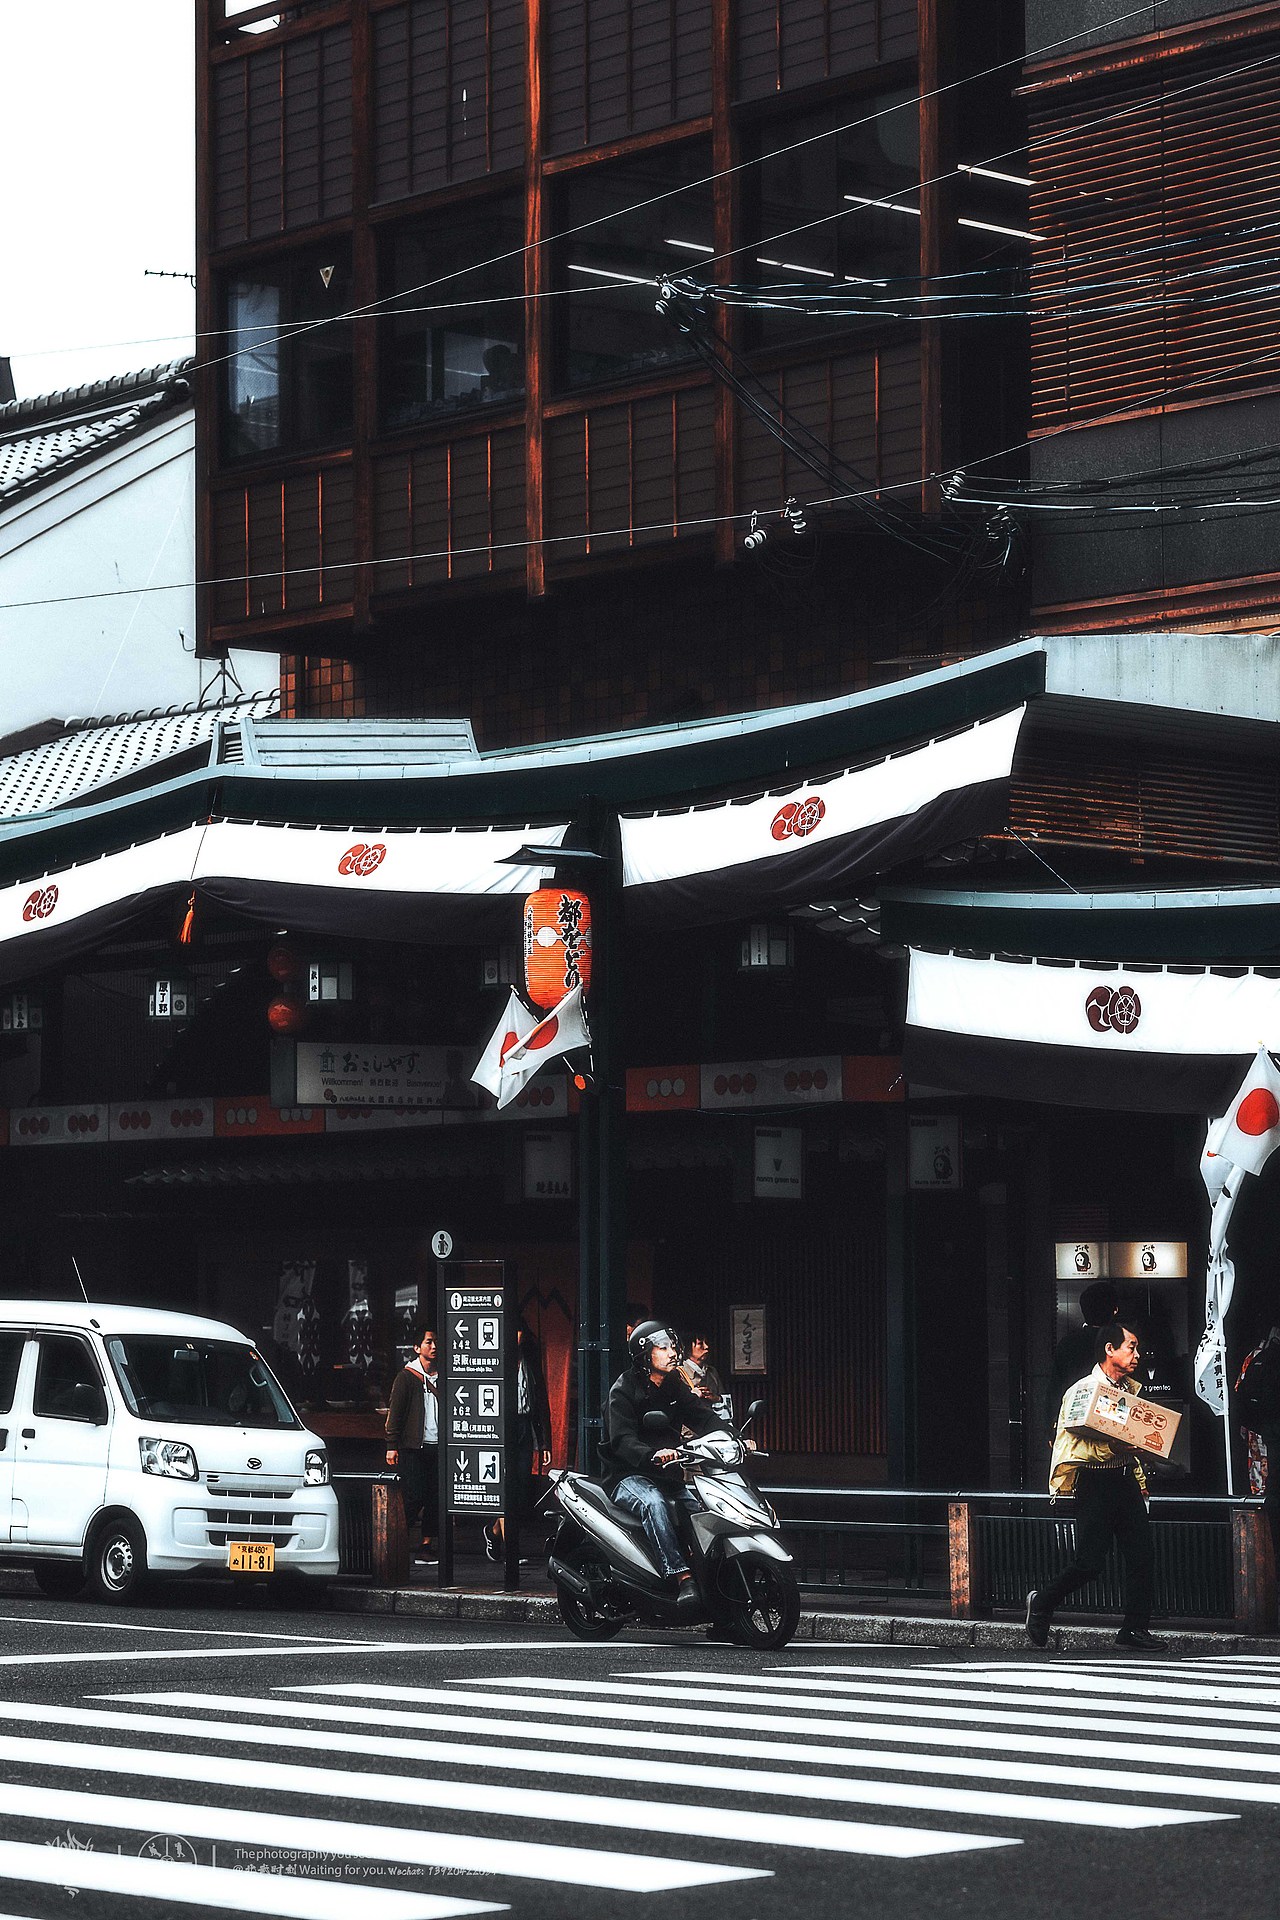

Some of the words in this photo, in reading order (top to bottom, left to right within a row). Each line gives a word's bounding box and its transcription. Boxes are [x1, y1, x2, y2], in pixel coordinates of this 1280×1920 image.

[159, 981, 168, 1013] 原了郭
[321, 1077, 363, 1087] Willkommen!
[1131, 1407, 1167, 1428] たまご
[242, 1554, 270, 1570] 11-81
